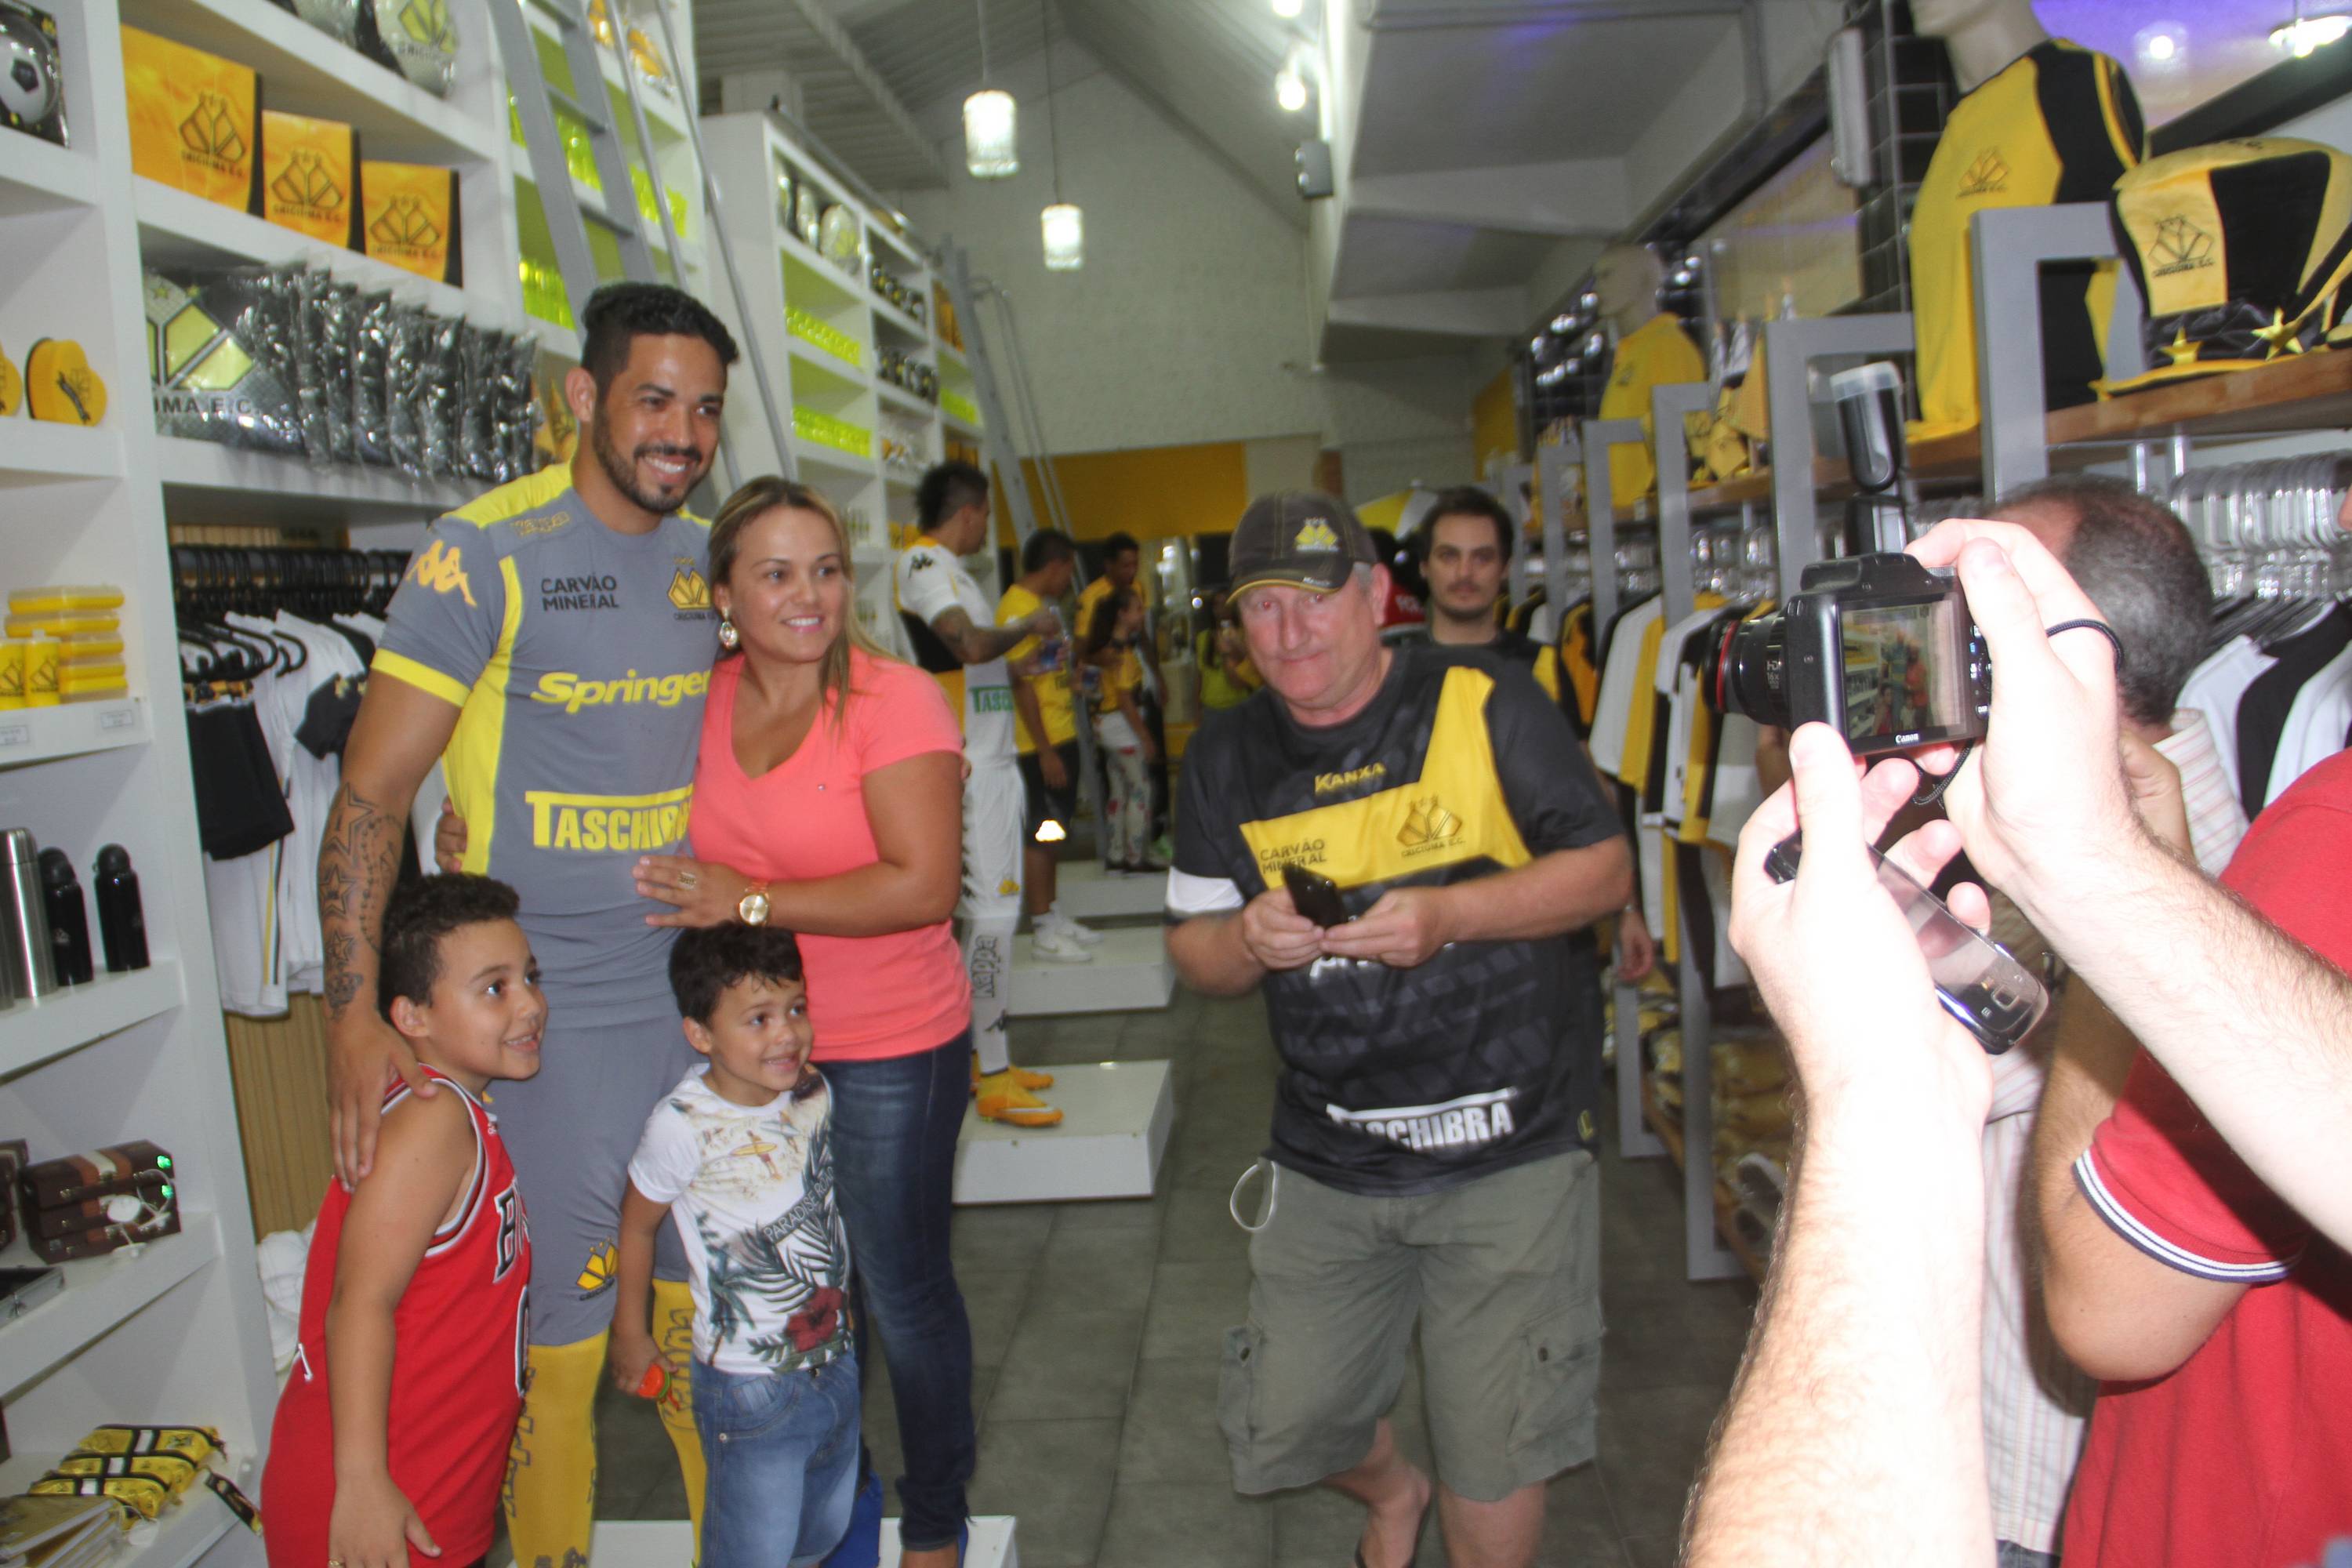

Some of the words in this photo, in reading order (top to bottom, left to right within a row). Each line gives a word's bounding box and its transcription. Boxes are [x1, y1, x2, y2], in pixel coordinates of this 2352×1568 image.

[530, 669, 711, 714] Springer
[1896, 733, 1919, 744] Canon
[1259, 838, 1325, 861] CARVÃO
[764, 1191, 817, 1243] PARADISE
